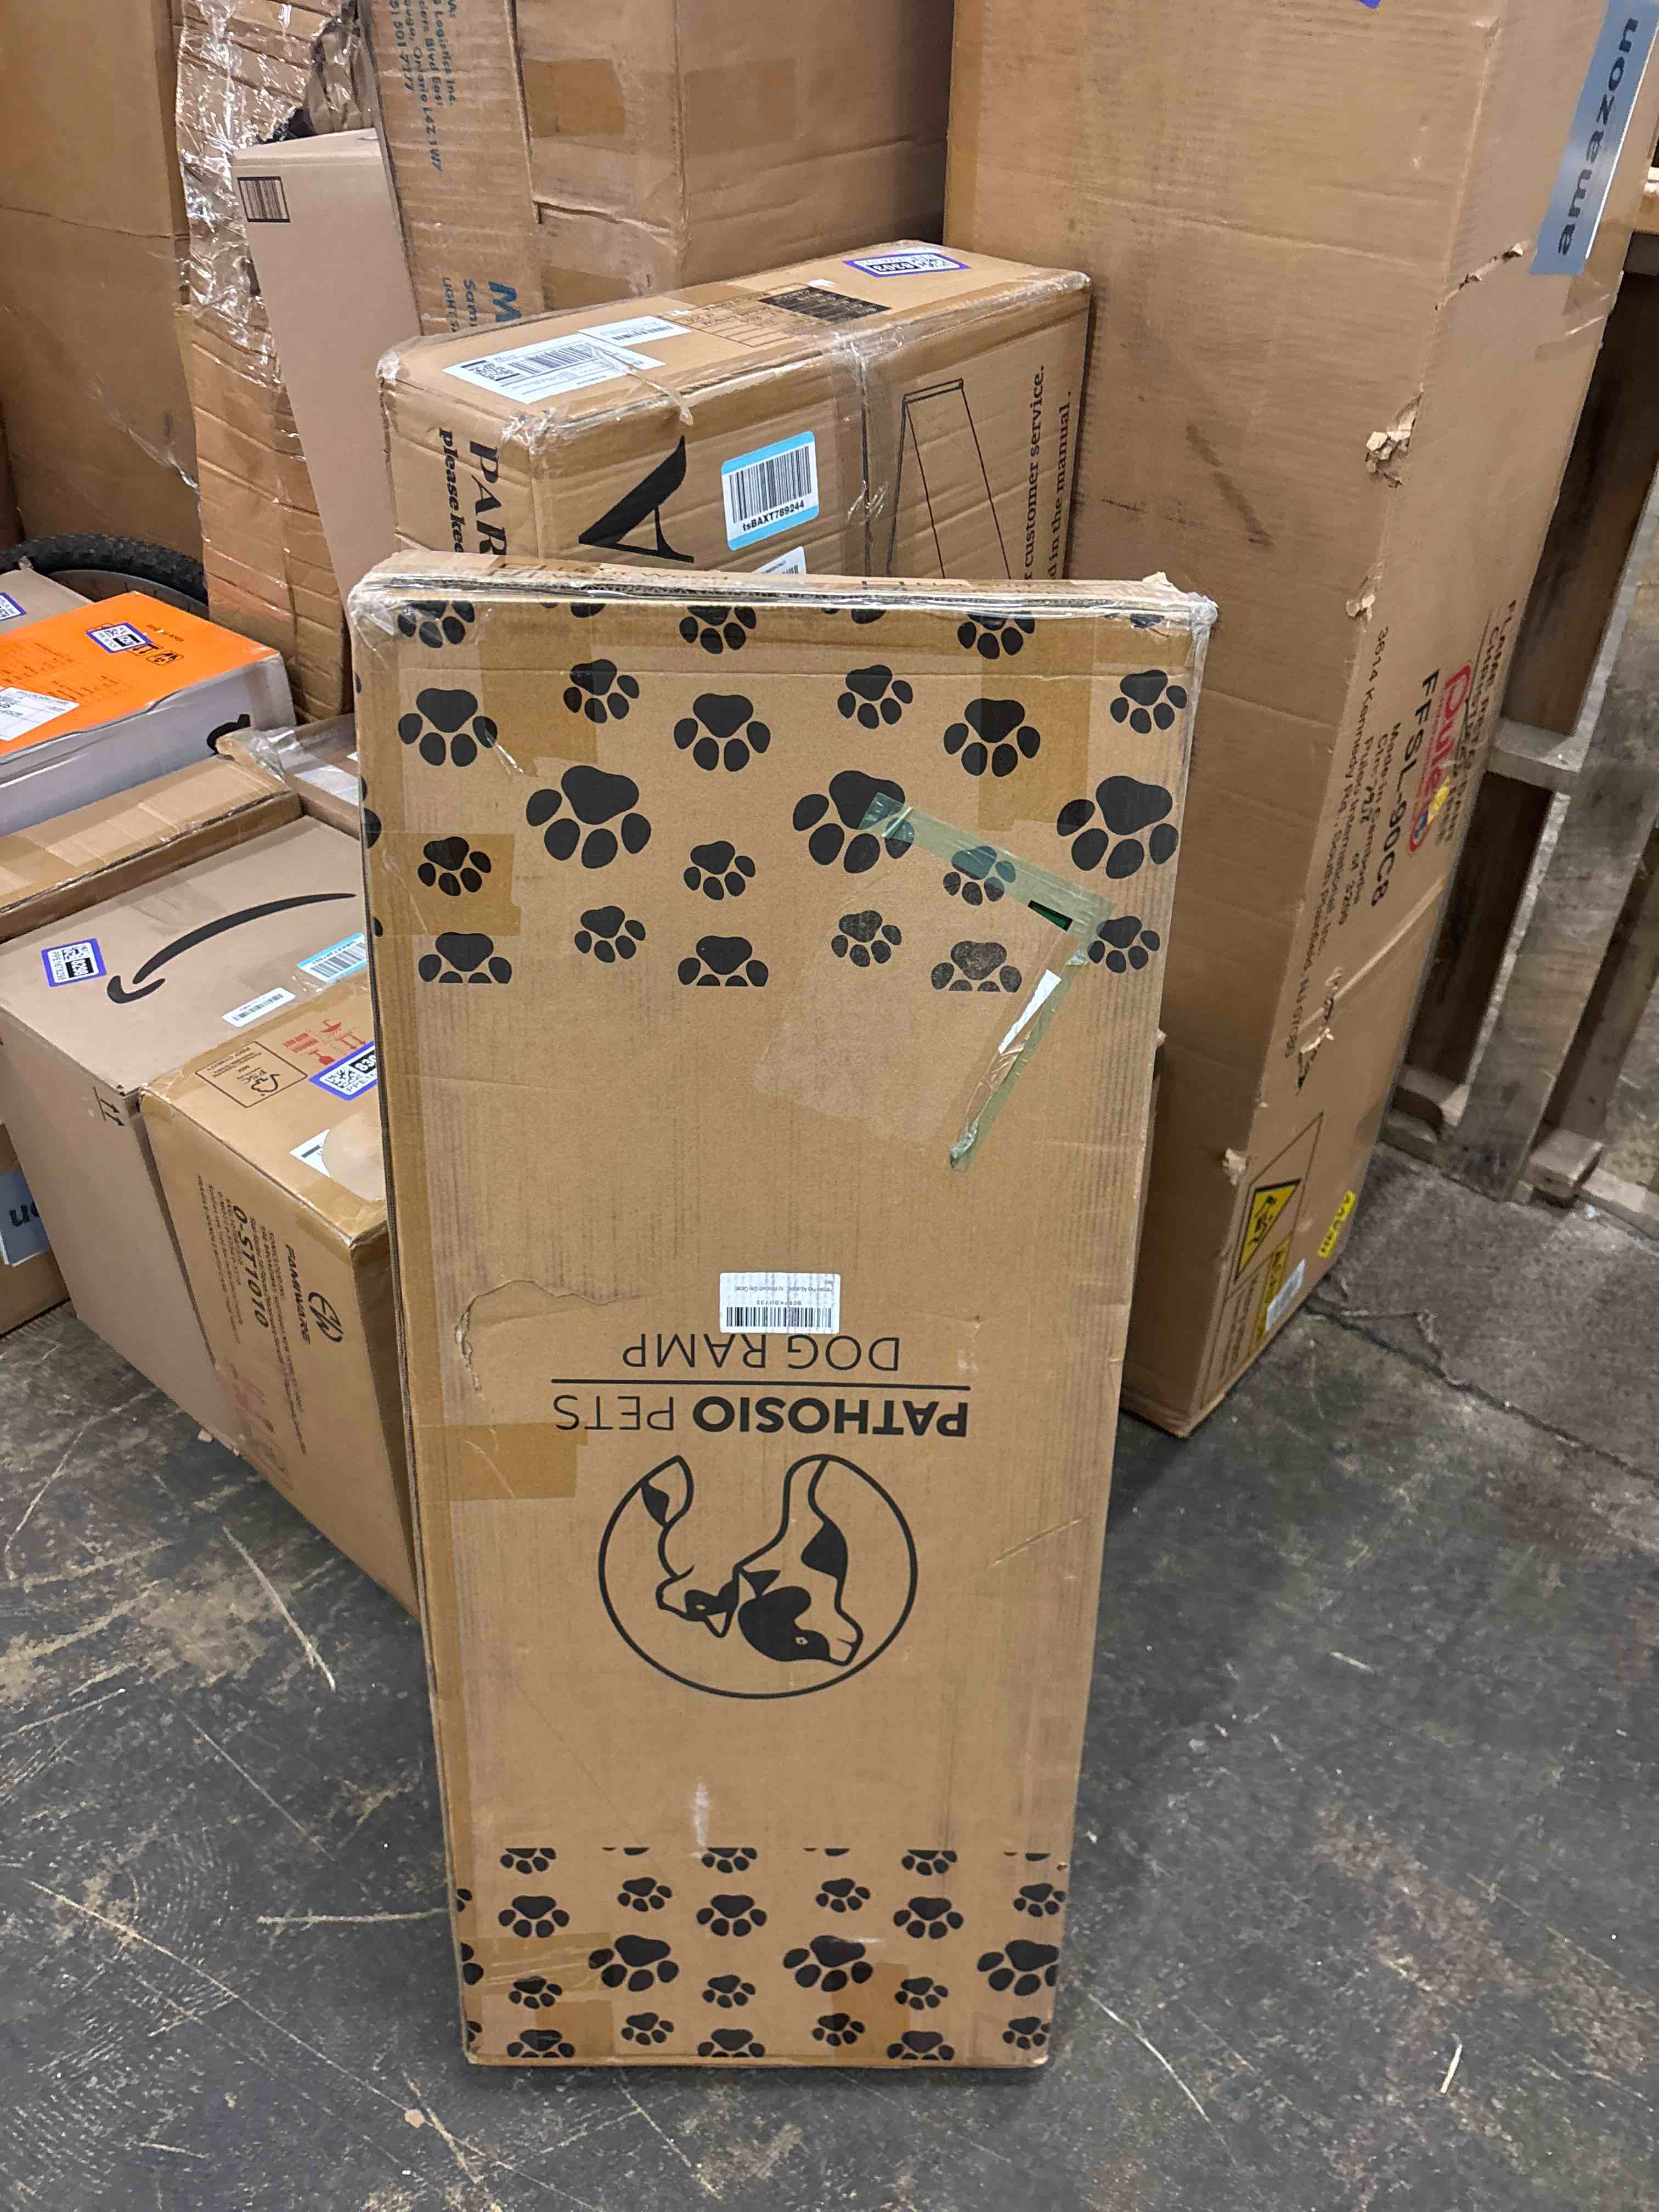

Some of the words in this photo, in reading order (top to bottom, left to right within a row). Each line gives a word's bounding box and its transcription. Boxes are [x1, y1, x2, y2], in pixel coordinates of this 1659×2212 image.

[1558, 16, 1639, 256] amazon
[1030, 364, 1045, 458] service.
[438, 427, 459, 511] please
[742, 500, 805, 532] tsBAXT789244
[1024, 460, 1039, 568] customer
[1051, 497, 1063, 533] the
[1048, 534, 1059, 562] in
[354, 1054, 377, 1071] 830
[623, 1333, 766, 1368] RAMP
[787, 1334, 900, 1371] DOG
[553, 1394, 674, 1431] PETS
[692, 1396, 968, 1437] PATHOSIO
